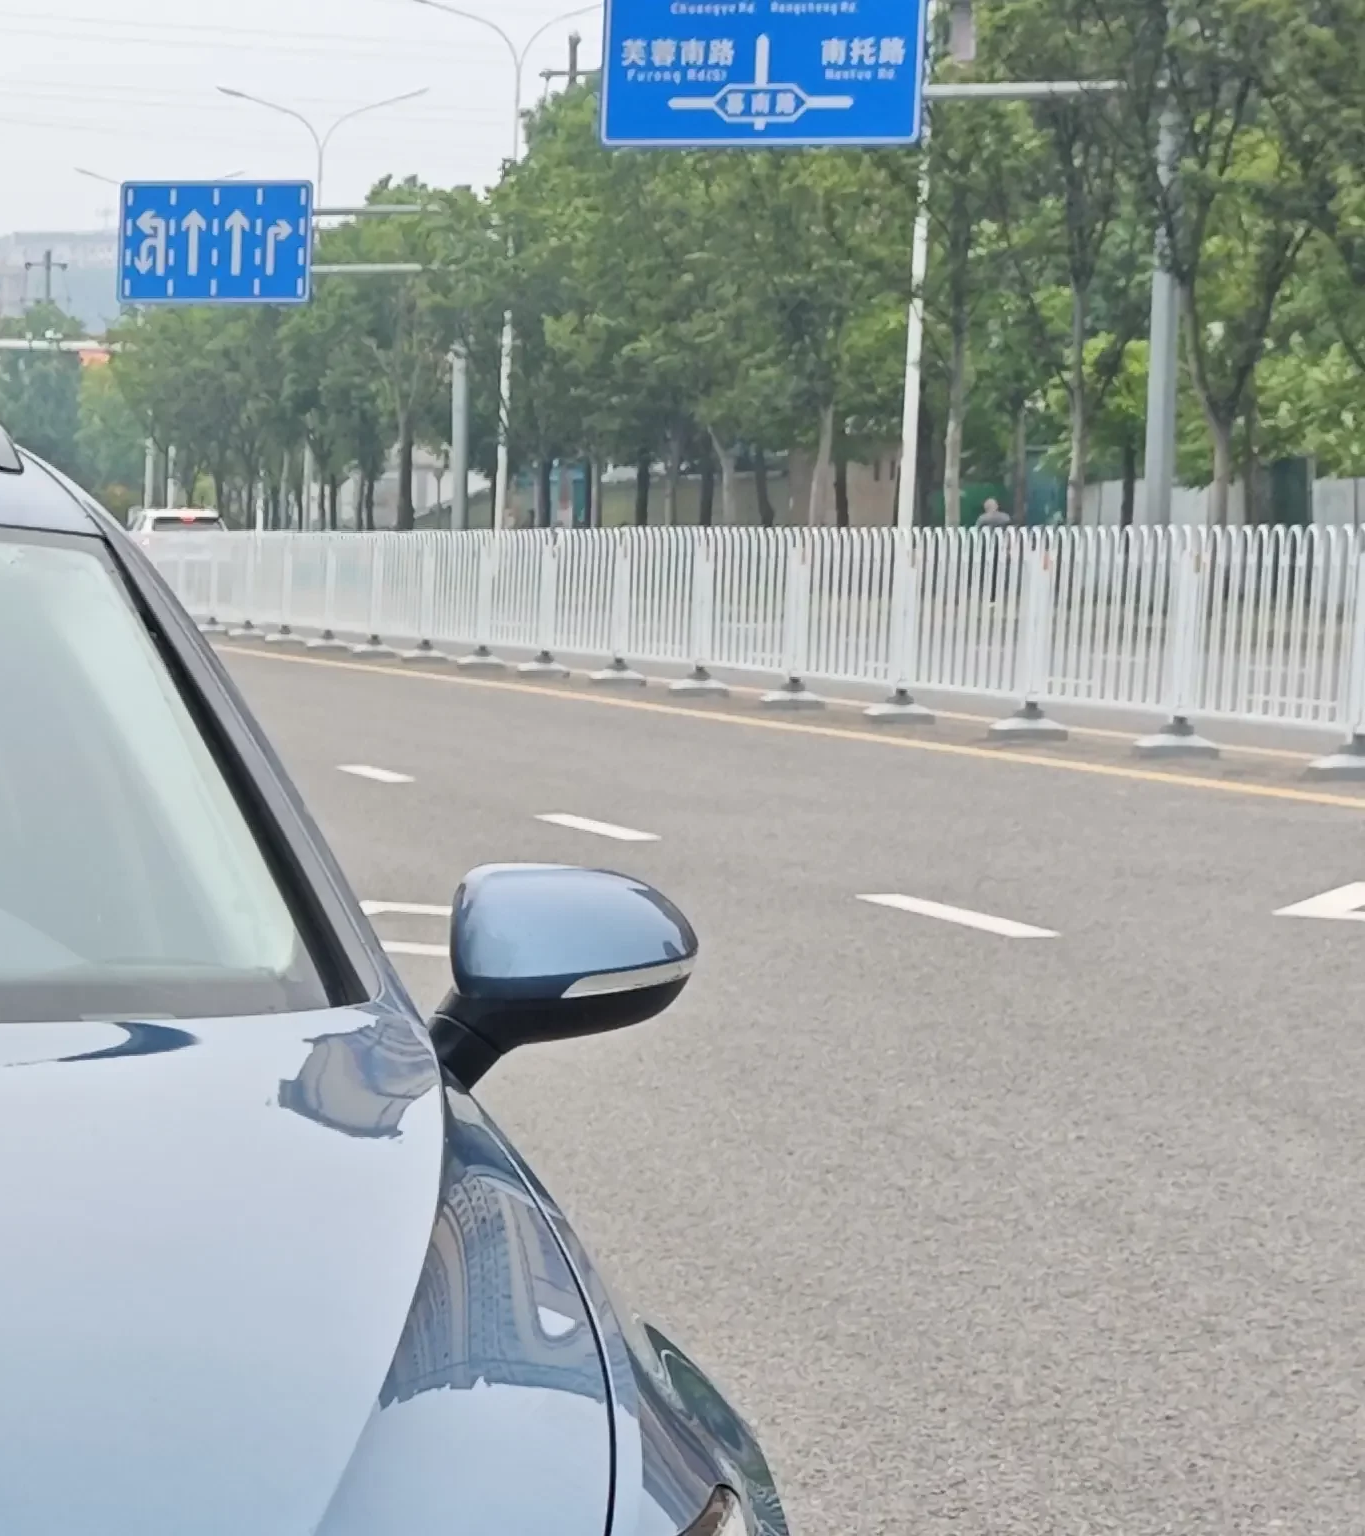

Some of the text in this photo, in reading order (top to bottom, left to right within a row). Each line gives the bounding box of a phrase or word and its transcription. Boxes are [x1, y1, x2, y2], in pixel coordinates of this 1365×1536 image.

[621, 38, 734, 67] 芙蓉南路
[821, 36, 906, 66] 南托路
